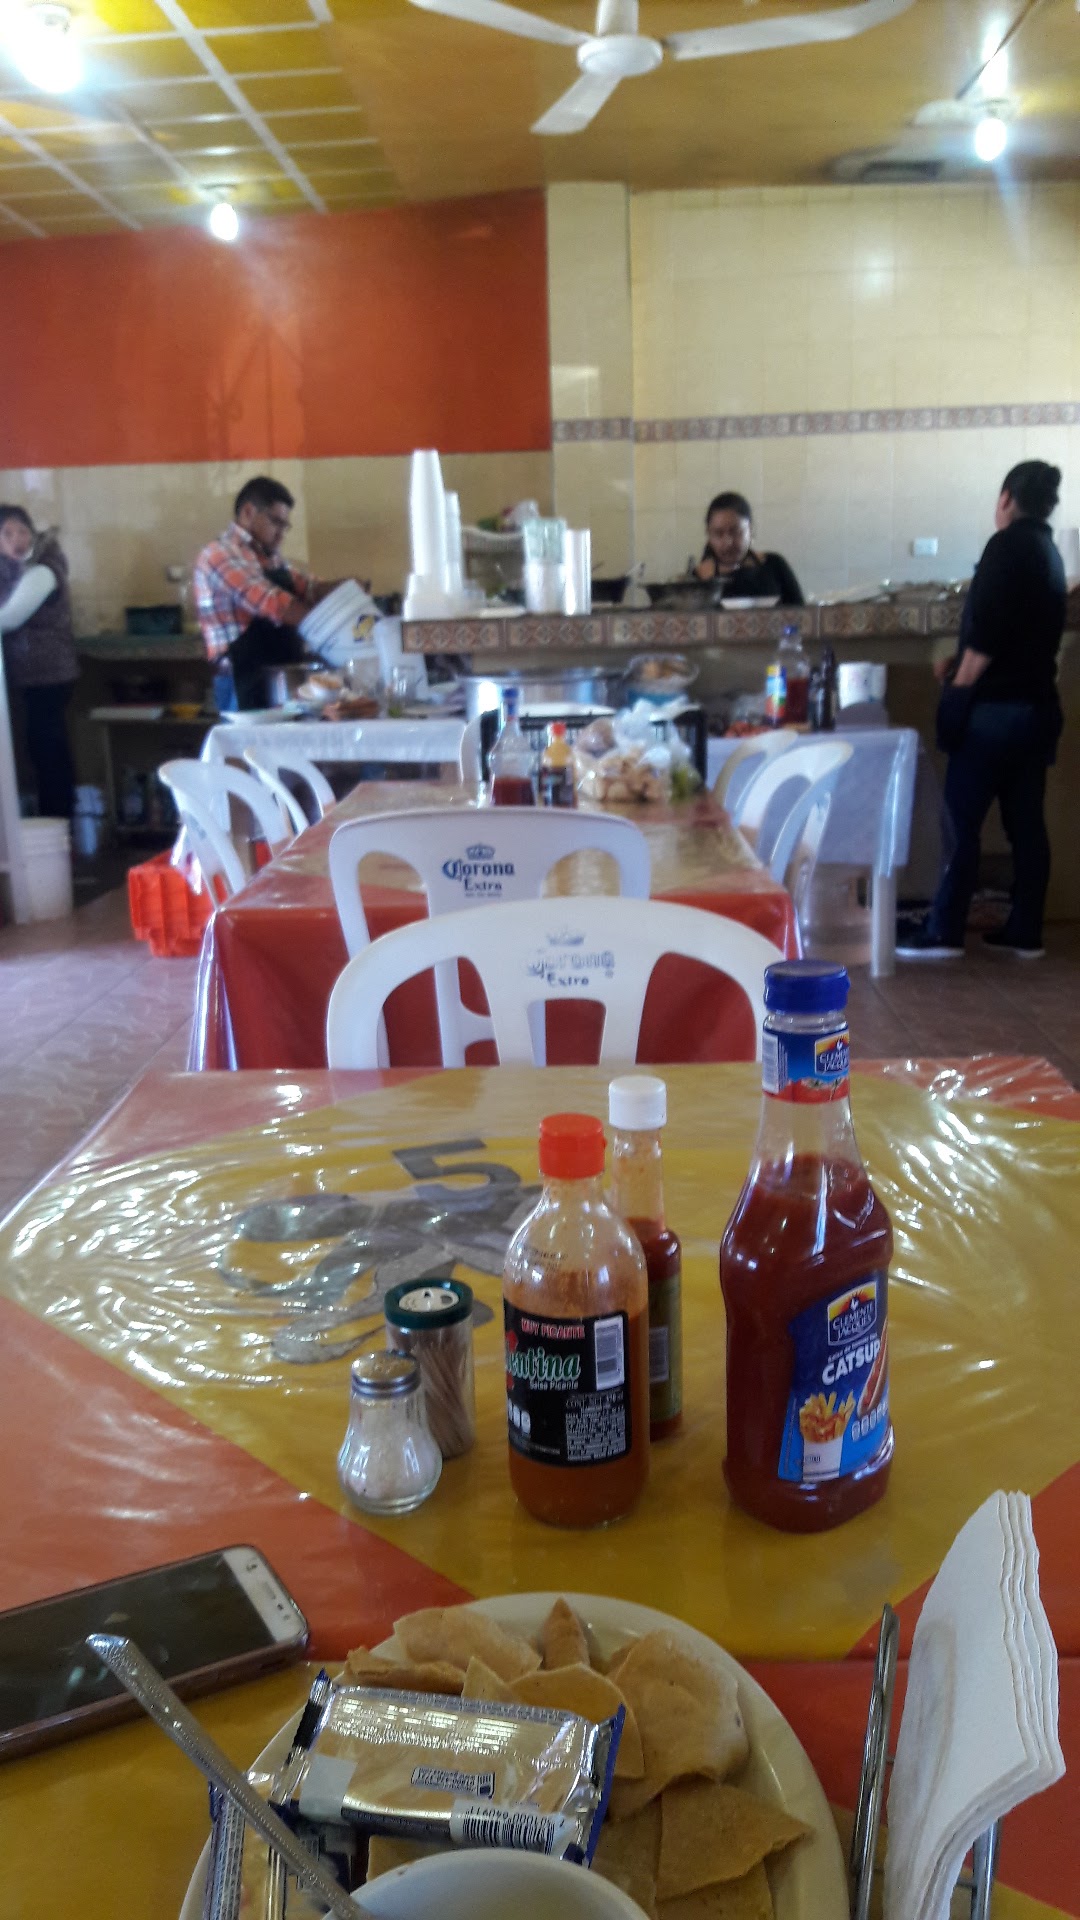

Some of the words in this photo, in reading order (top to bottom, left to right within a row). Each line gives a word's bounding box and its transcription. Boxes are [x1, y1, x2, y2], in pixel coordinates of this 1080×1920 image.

[442, 859, 515, 881] Corona
[464, 879, 502, 891] Extra
[546, 972, 589, 987] Extra
[391, 1139, 521, 1211] 5
[521, 1317, 540, 1336] MUY
[541, 1323, 586, 1340] PICANTE
[832, 1302, 873, 1331] CLEMENTE
[507, 1346, 581, 1381] entina
[821, 1339, 881, 1386] CATSUP
